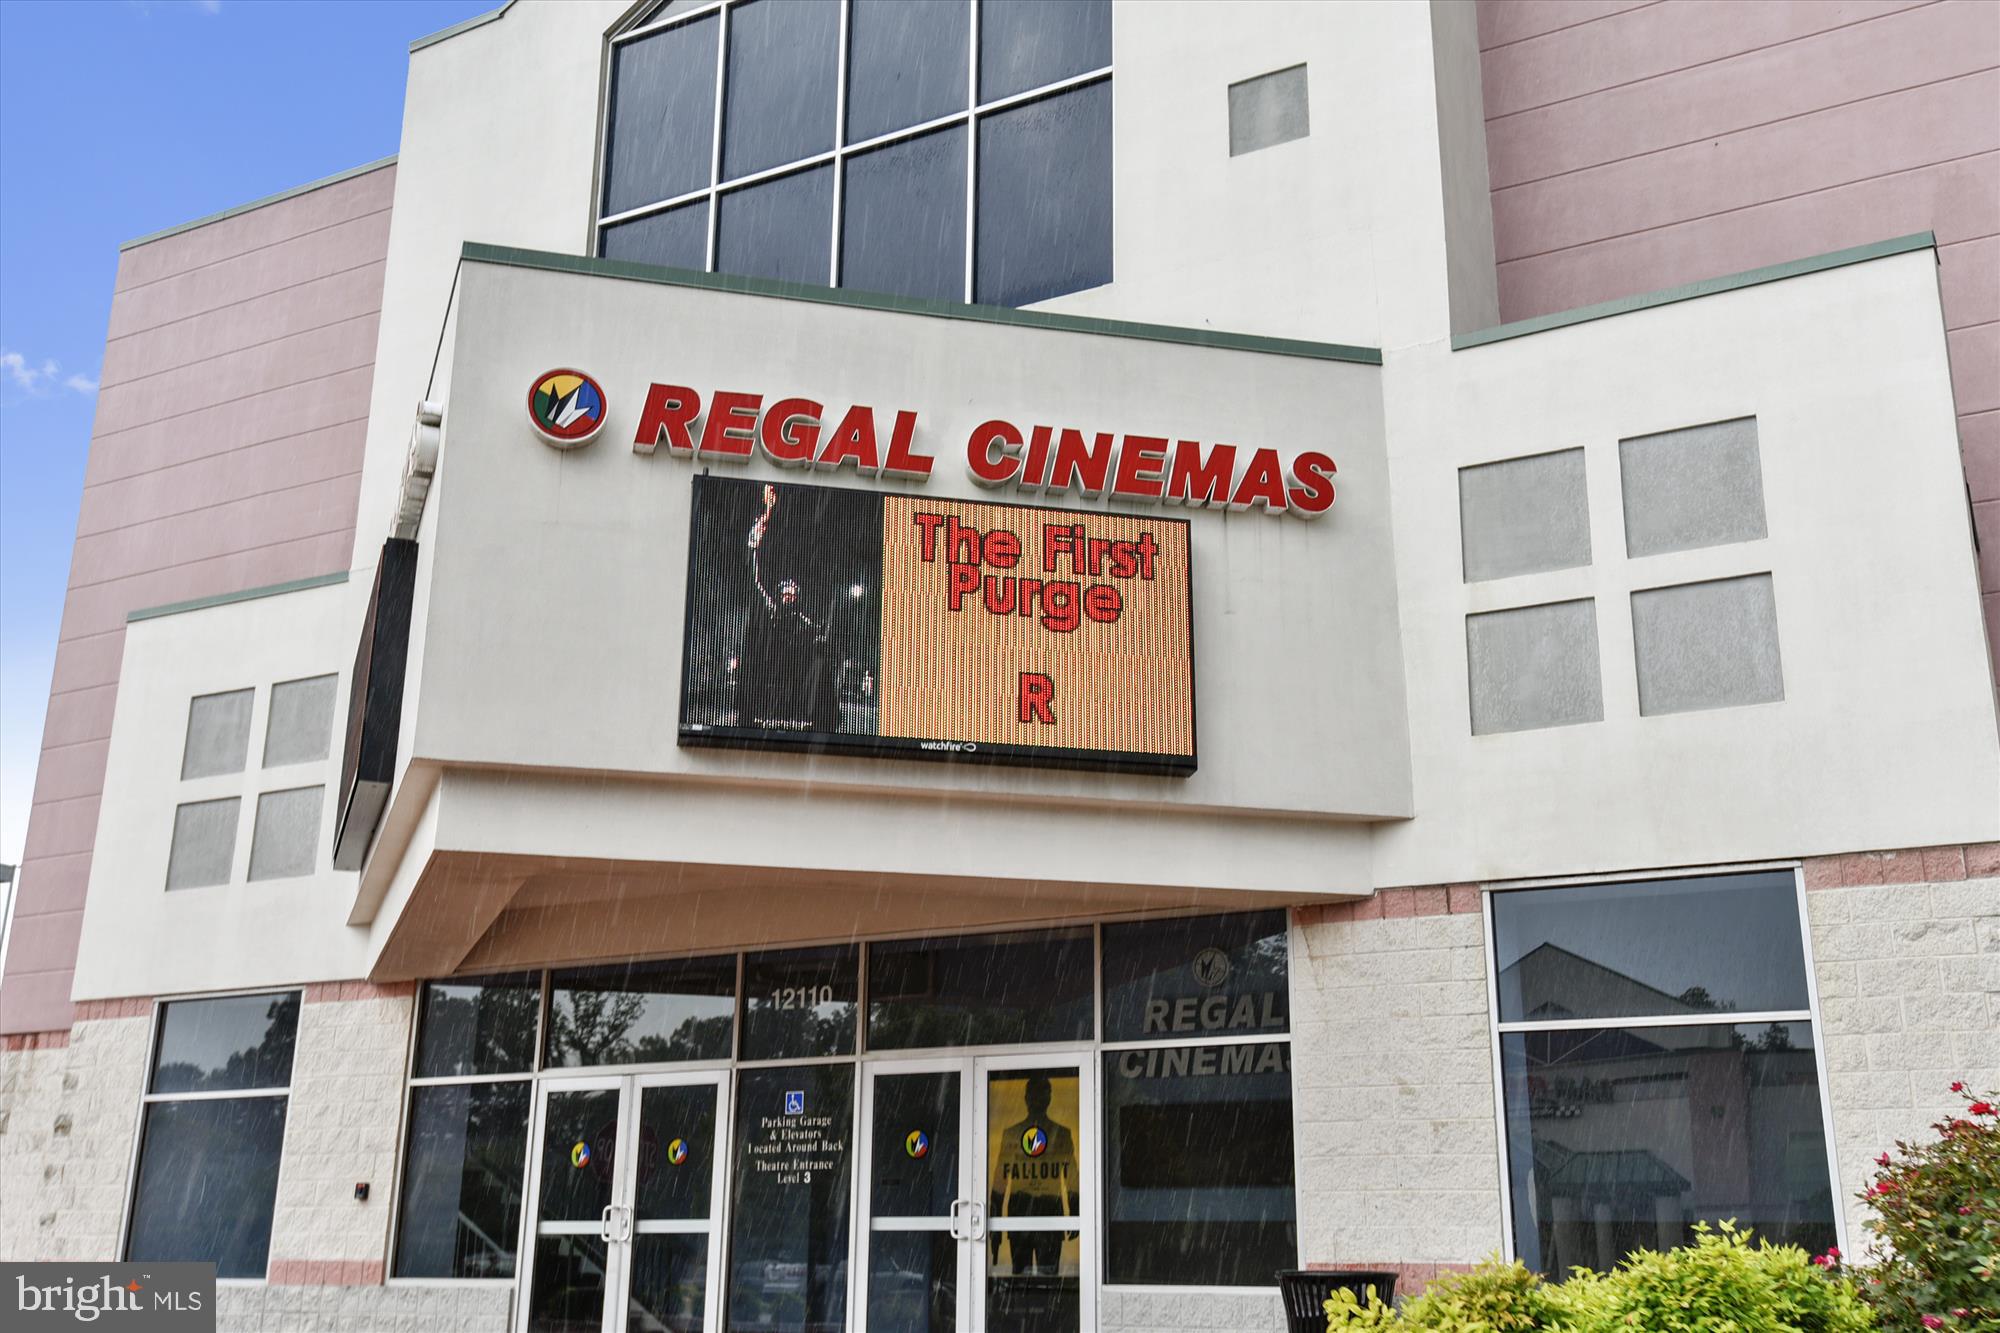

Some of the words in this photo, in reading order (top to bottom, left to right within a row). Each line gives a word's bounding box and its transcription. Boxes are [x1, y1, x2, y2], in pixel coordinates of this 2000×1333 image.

[633, 383, 935, 479] REGAL
[966, 420, 1337, 516] CINEMAS
[914, 512, 1022, 569] The
[1042, 523, 1159, 581] First
[948, 562, 1123, 633] Purge
[1018, 671, 1057, 725] R
[920, 741, 961, 752] watchfire
[771, 985, 833, 1011] 12110
[1143, 992, 1284, 1034] REGAL
[1119, 1043, 1291, 1079] CINEMA
[761, 1116, 797, 1129] Parking
[800, 1116, 832, 1127] Garage
[769, 1129, 777, 1141] &
[781, 1129, 822, 1140] Elevators
[748, 1142, 782, 1154] Located
[785, 1141, 818, 1153] Around
[822, 1140, 844, 1152] Back
[756, 1160, 789, 1172] Theatre
[793, 1158, 834, 1170] Entrance
[1003, 1162, 1070, 1179] FALLOUT
[777, 1172, 800, 1184] Level
[803, 1171, 811, 1184] 3
